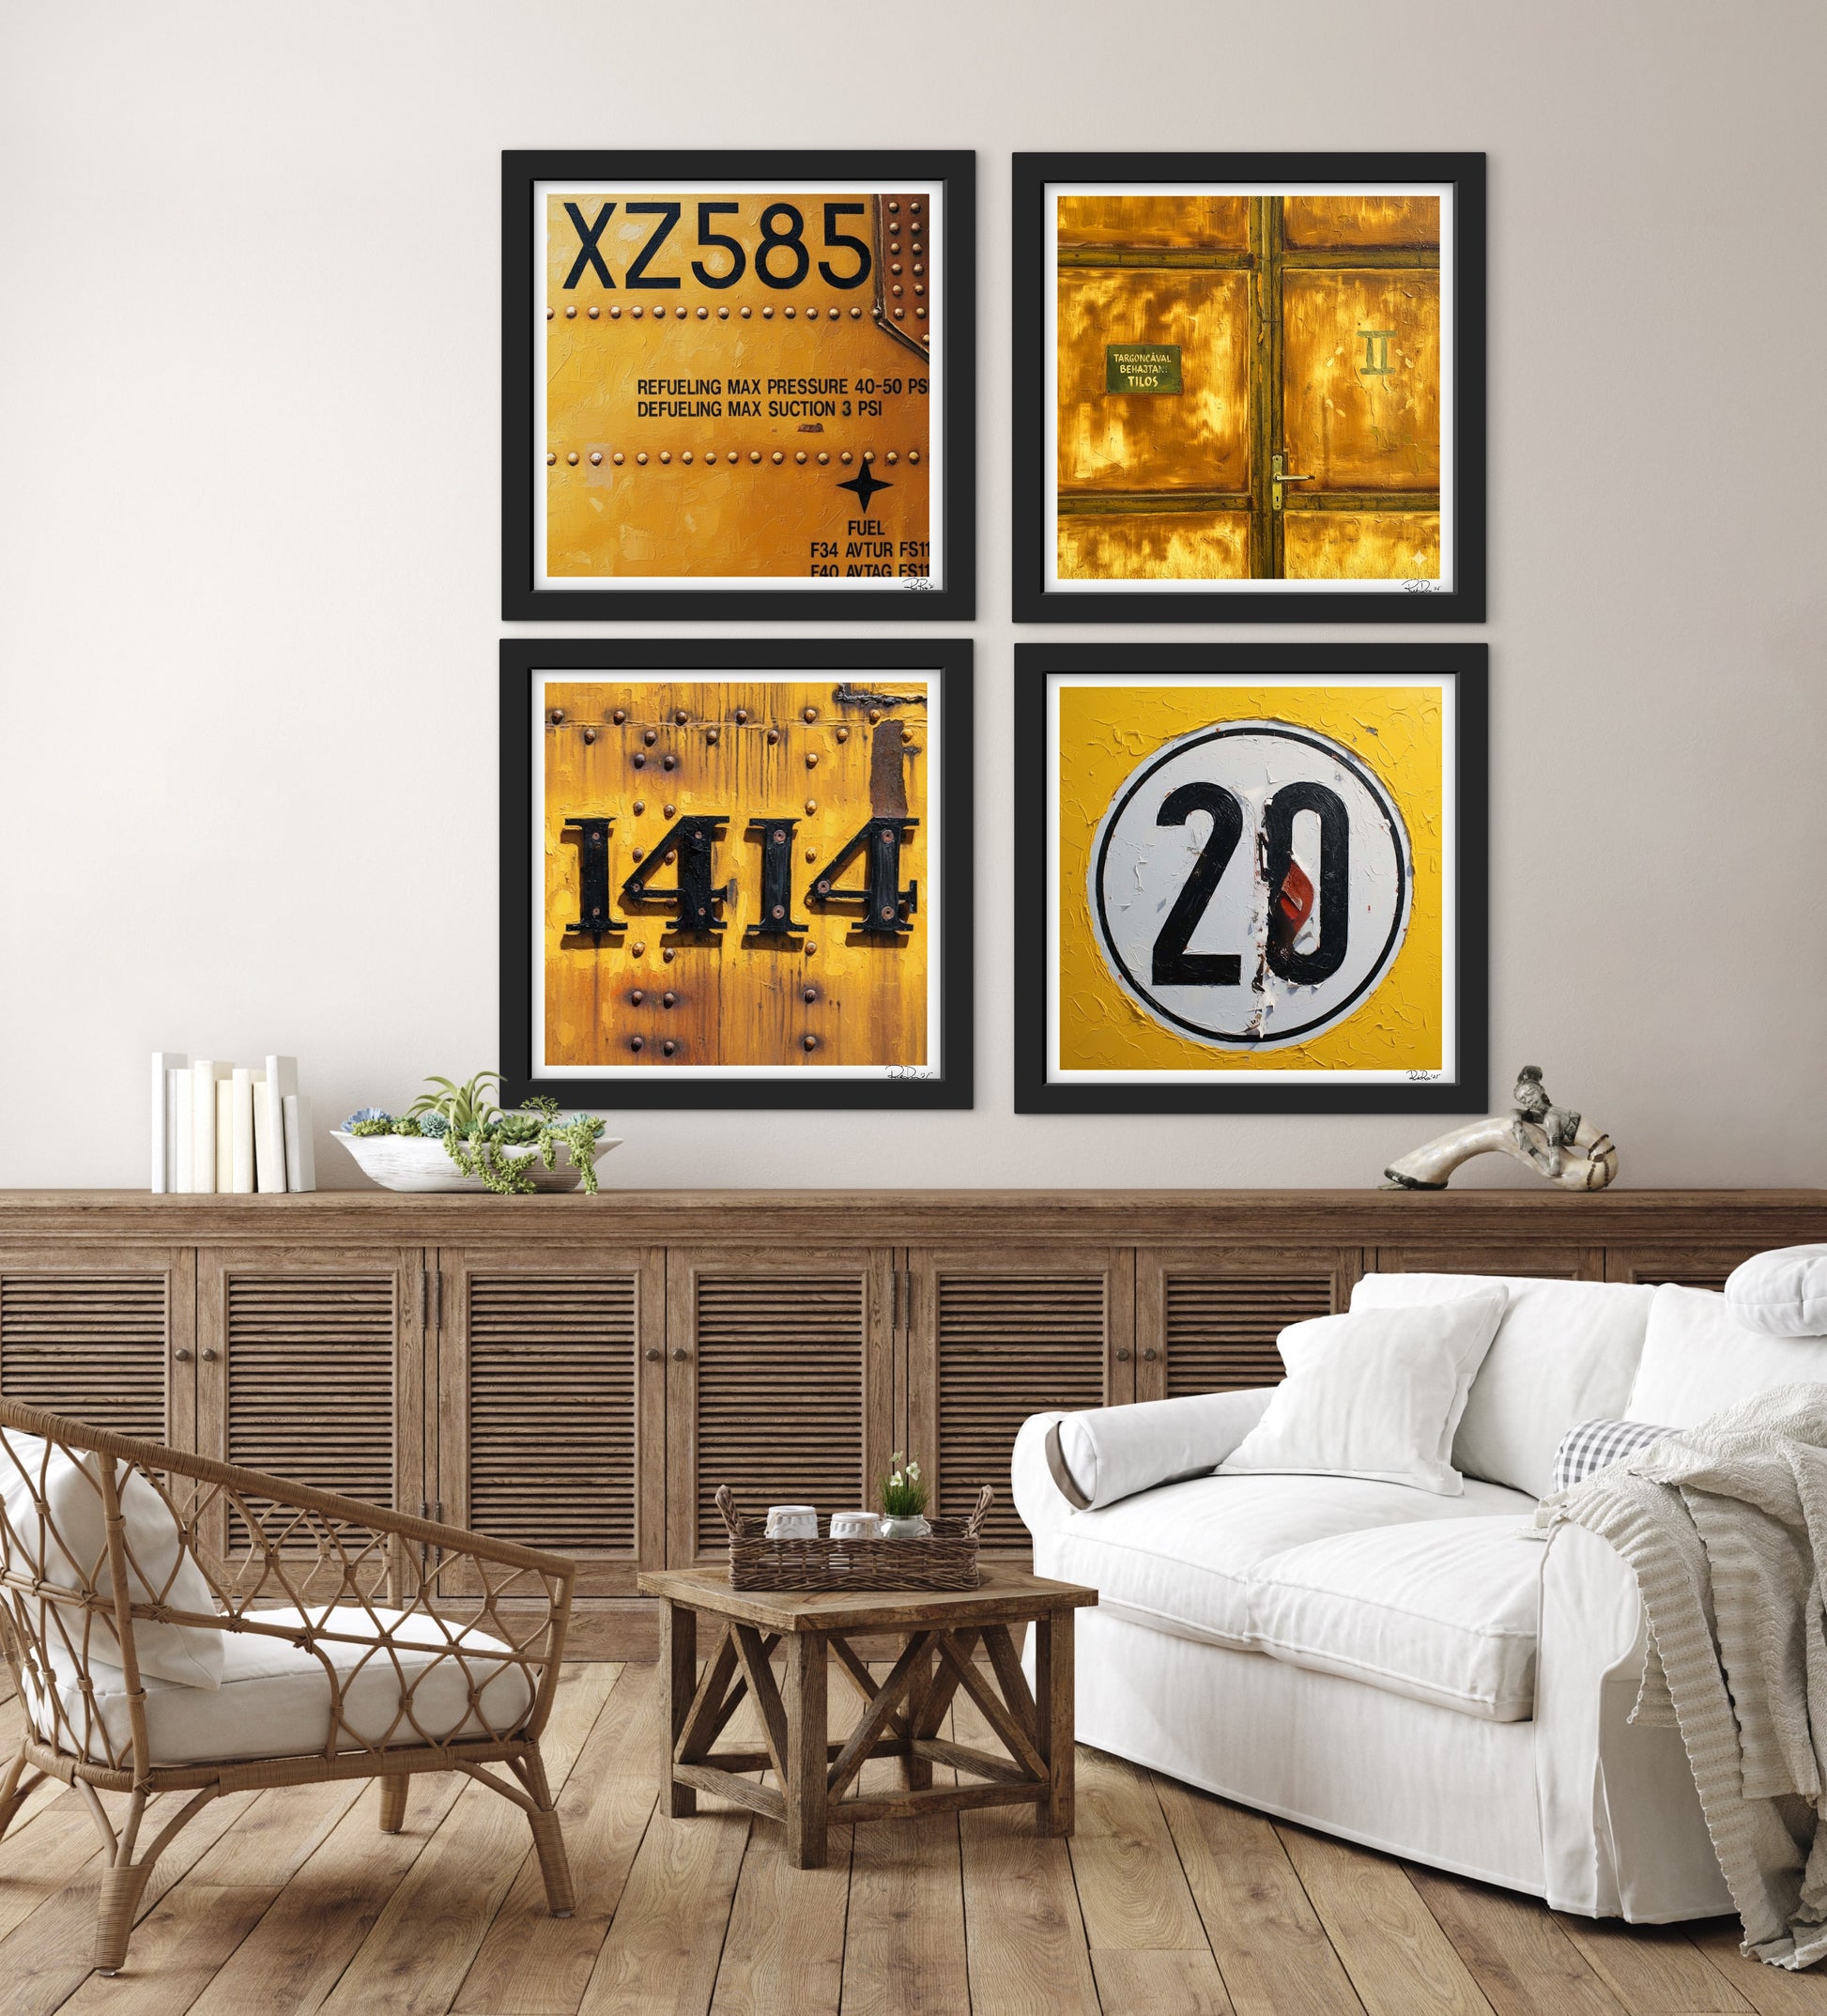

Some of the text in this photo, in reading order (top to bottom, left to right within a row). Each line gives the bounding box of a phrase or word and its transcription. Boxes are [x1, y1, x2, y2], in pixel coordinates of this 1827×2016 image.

[562, 202, 873, 290] XZ585
[1113, 353, 1172, 362] TARGONCÁVAL
[637, 379, 722, 395] REFUELING
[728, 378, 761, 395] MAX
[767, 377, 849, 394] PRESSURE
[854, 377, 902, 394] 40-50
[1128, 376, 1159, 387] TILOS
[637, 400, 883, 417] DEFUELING MAX SUCTION 3 PSI
[848, 520, 885, 536] FUEL
[810, 542, 838, 559] F34
[846, 542, 893, 558] AVTUR
[810, 564, 839, 577] F40
[846, 563, 892, 577] AVTAG
[563, 815, 920, 931] 1414
[1152, 781, 1350, 986] 20
